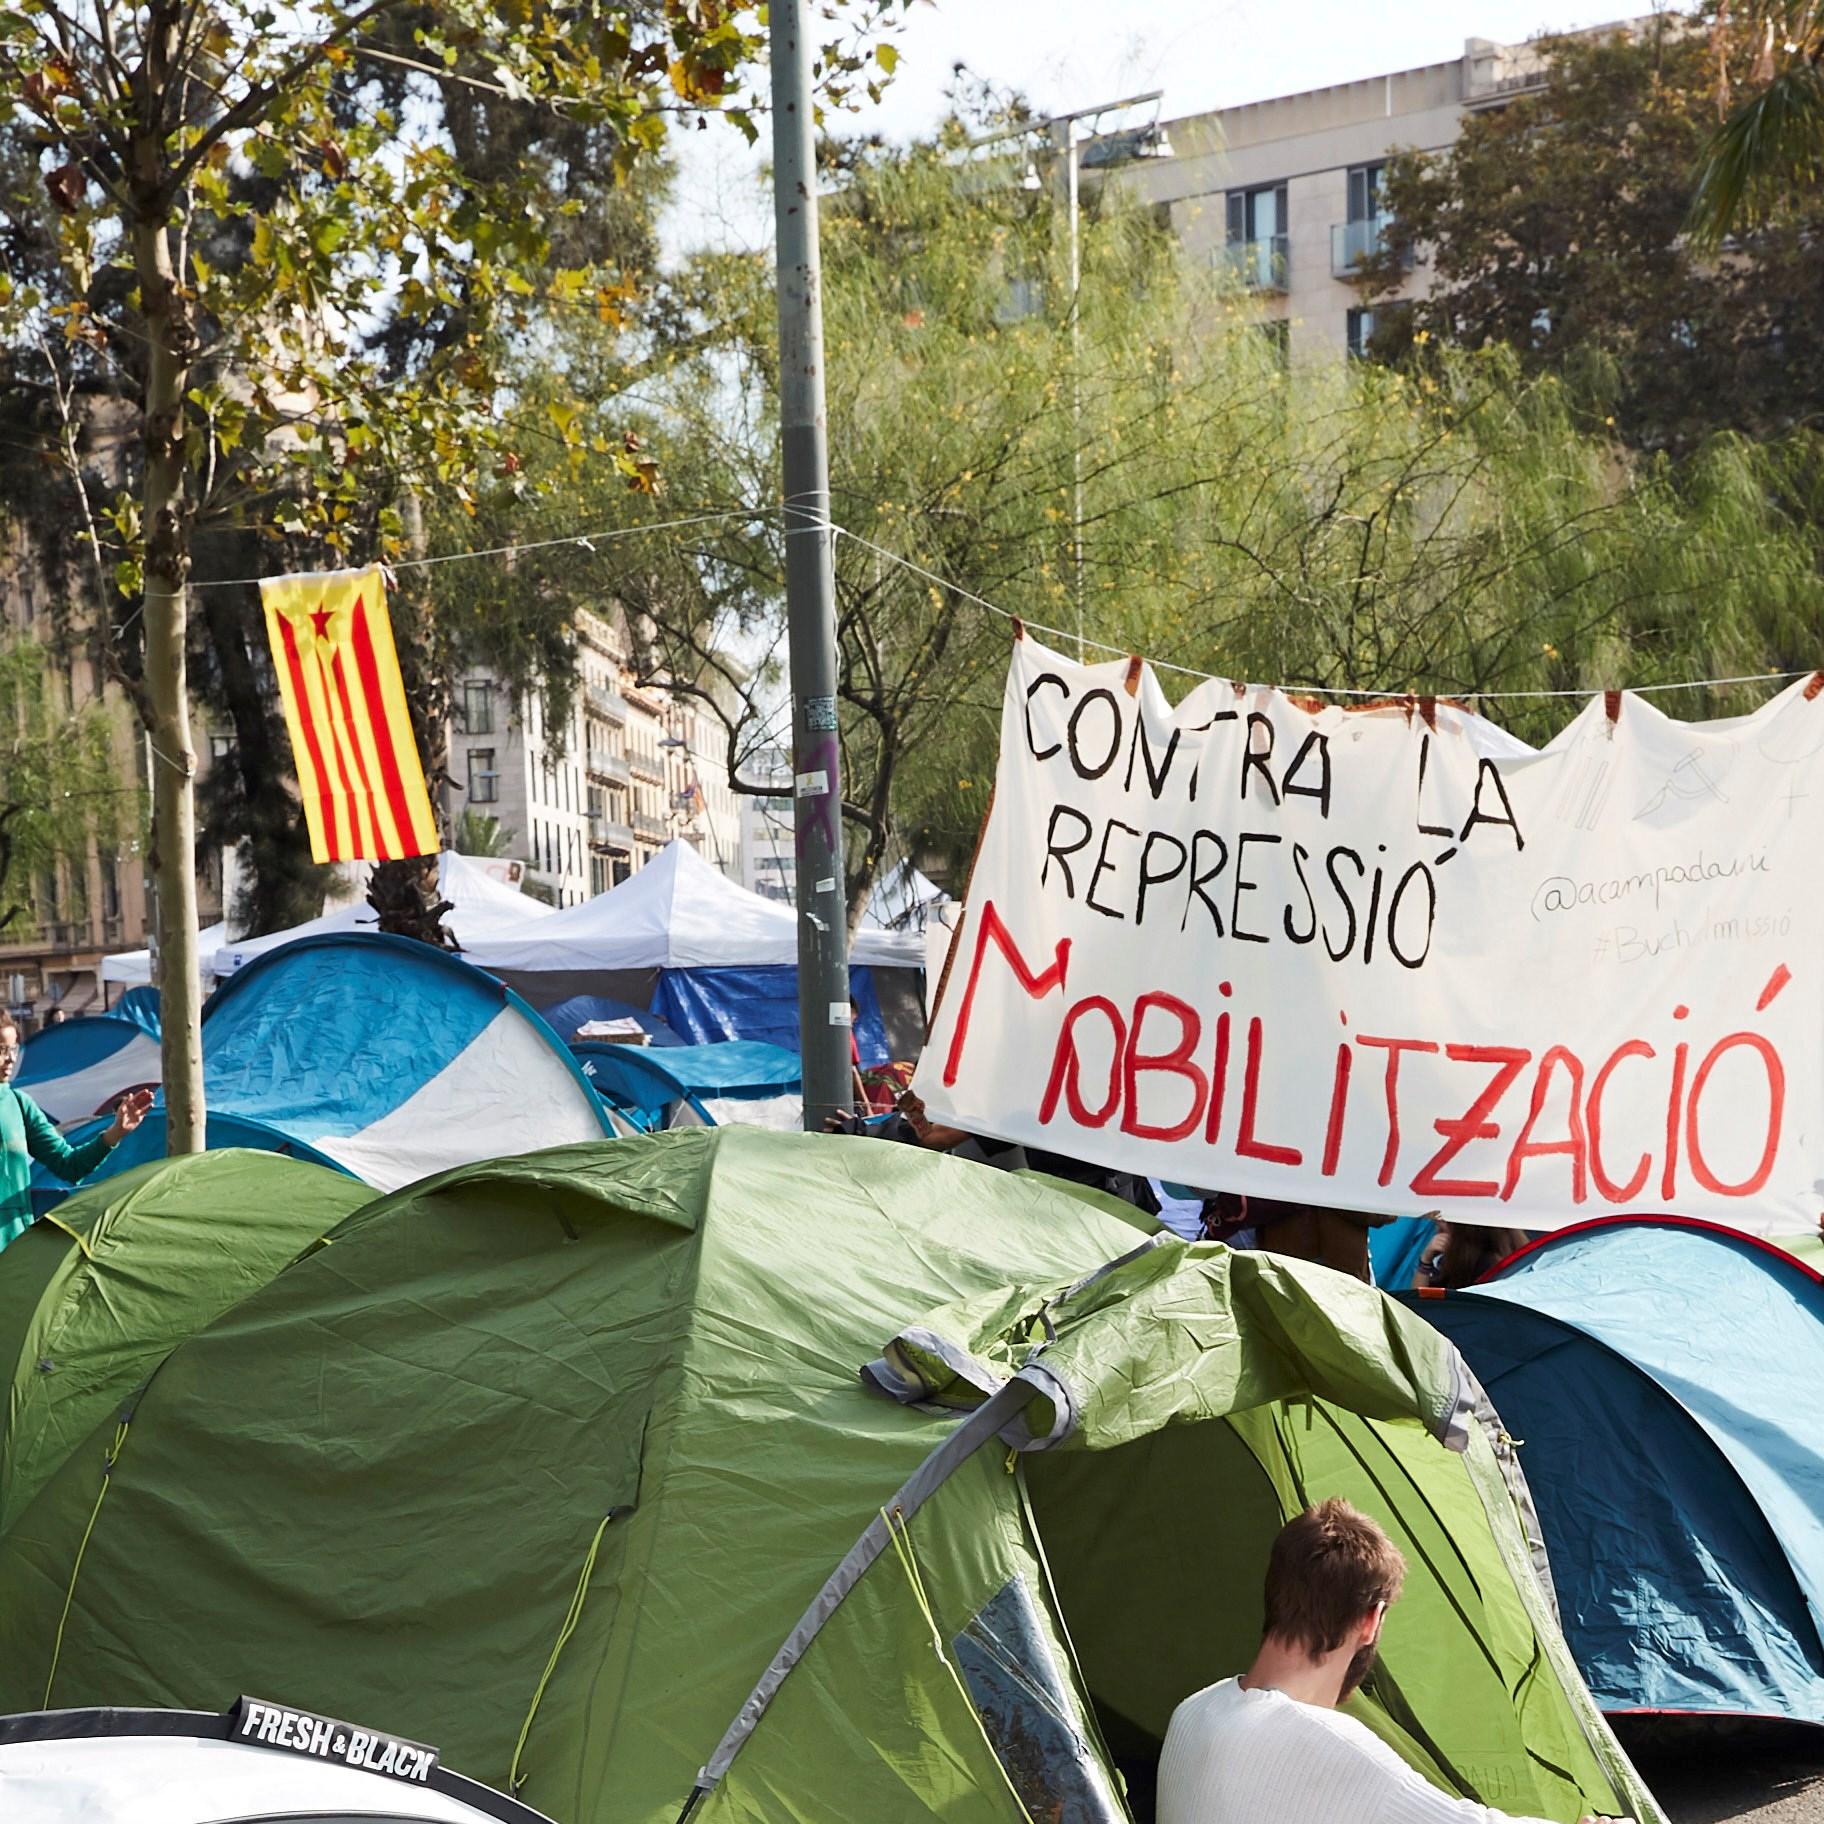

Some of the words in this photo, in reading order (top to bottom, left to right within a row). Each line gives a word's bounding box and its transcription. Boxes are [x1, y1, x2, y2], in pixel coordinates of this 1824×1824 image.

[1026, 673, 1330, 818] CONTRA
[1419, 735, 1524, 851] LA
[1042, 805, 1459, 970] REPRESSIÓ
[944, 901, 1792, 1204] MOBILITZACIÓ
